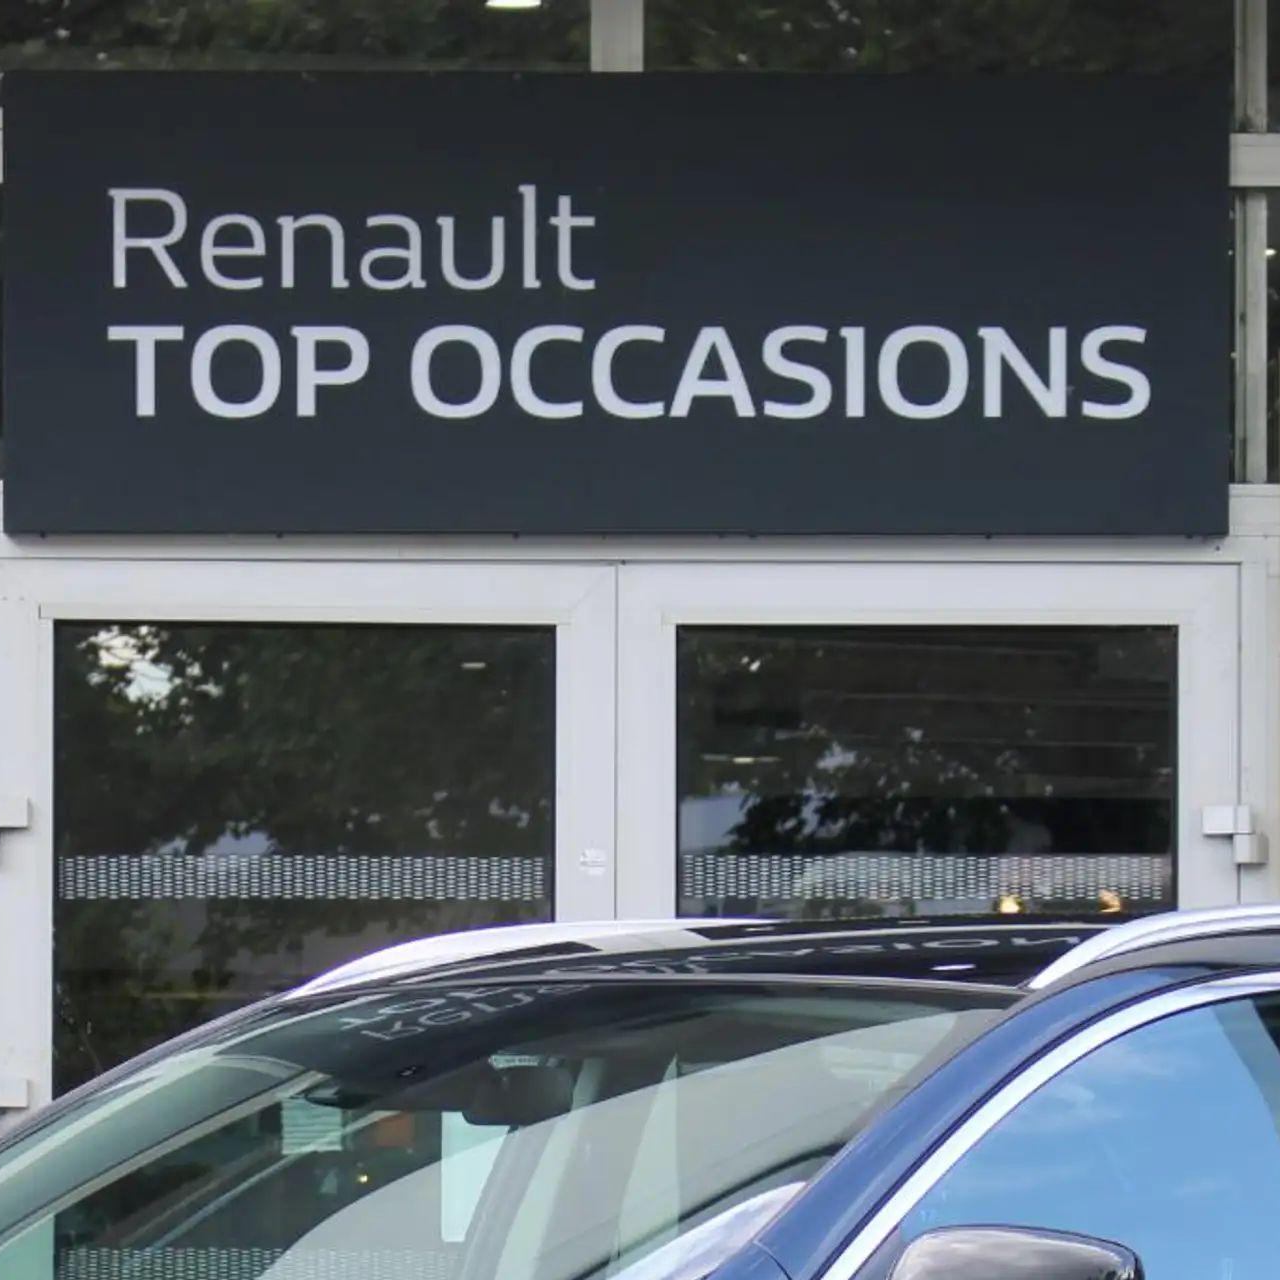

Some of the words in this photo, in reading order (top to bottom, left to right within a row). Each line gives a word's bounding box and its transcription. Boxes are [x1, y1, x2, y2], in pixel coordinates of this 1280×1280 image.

[107, 184, 596, 292] Renault
[107, 324, 371, 418] TOP
[408, 324, 1153, 419] OCCASIONS
